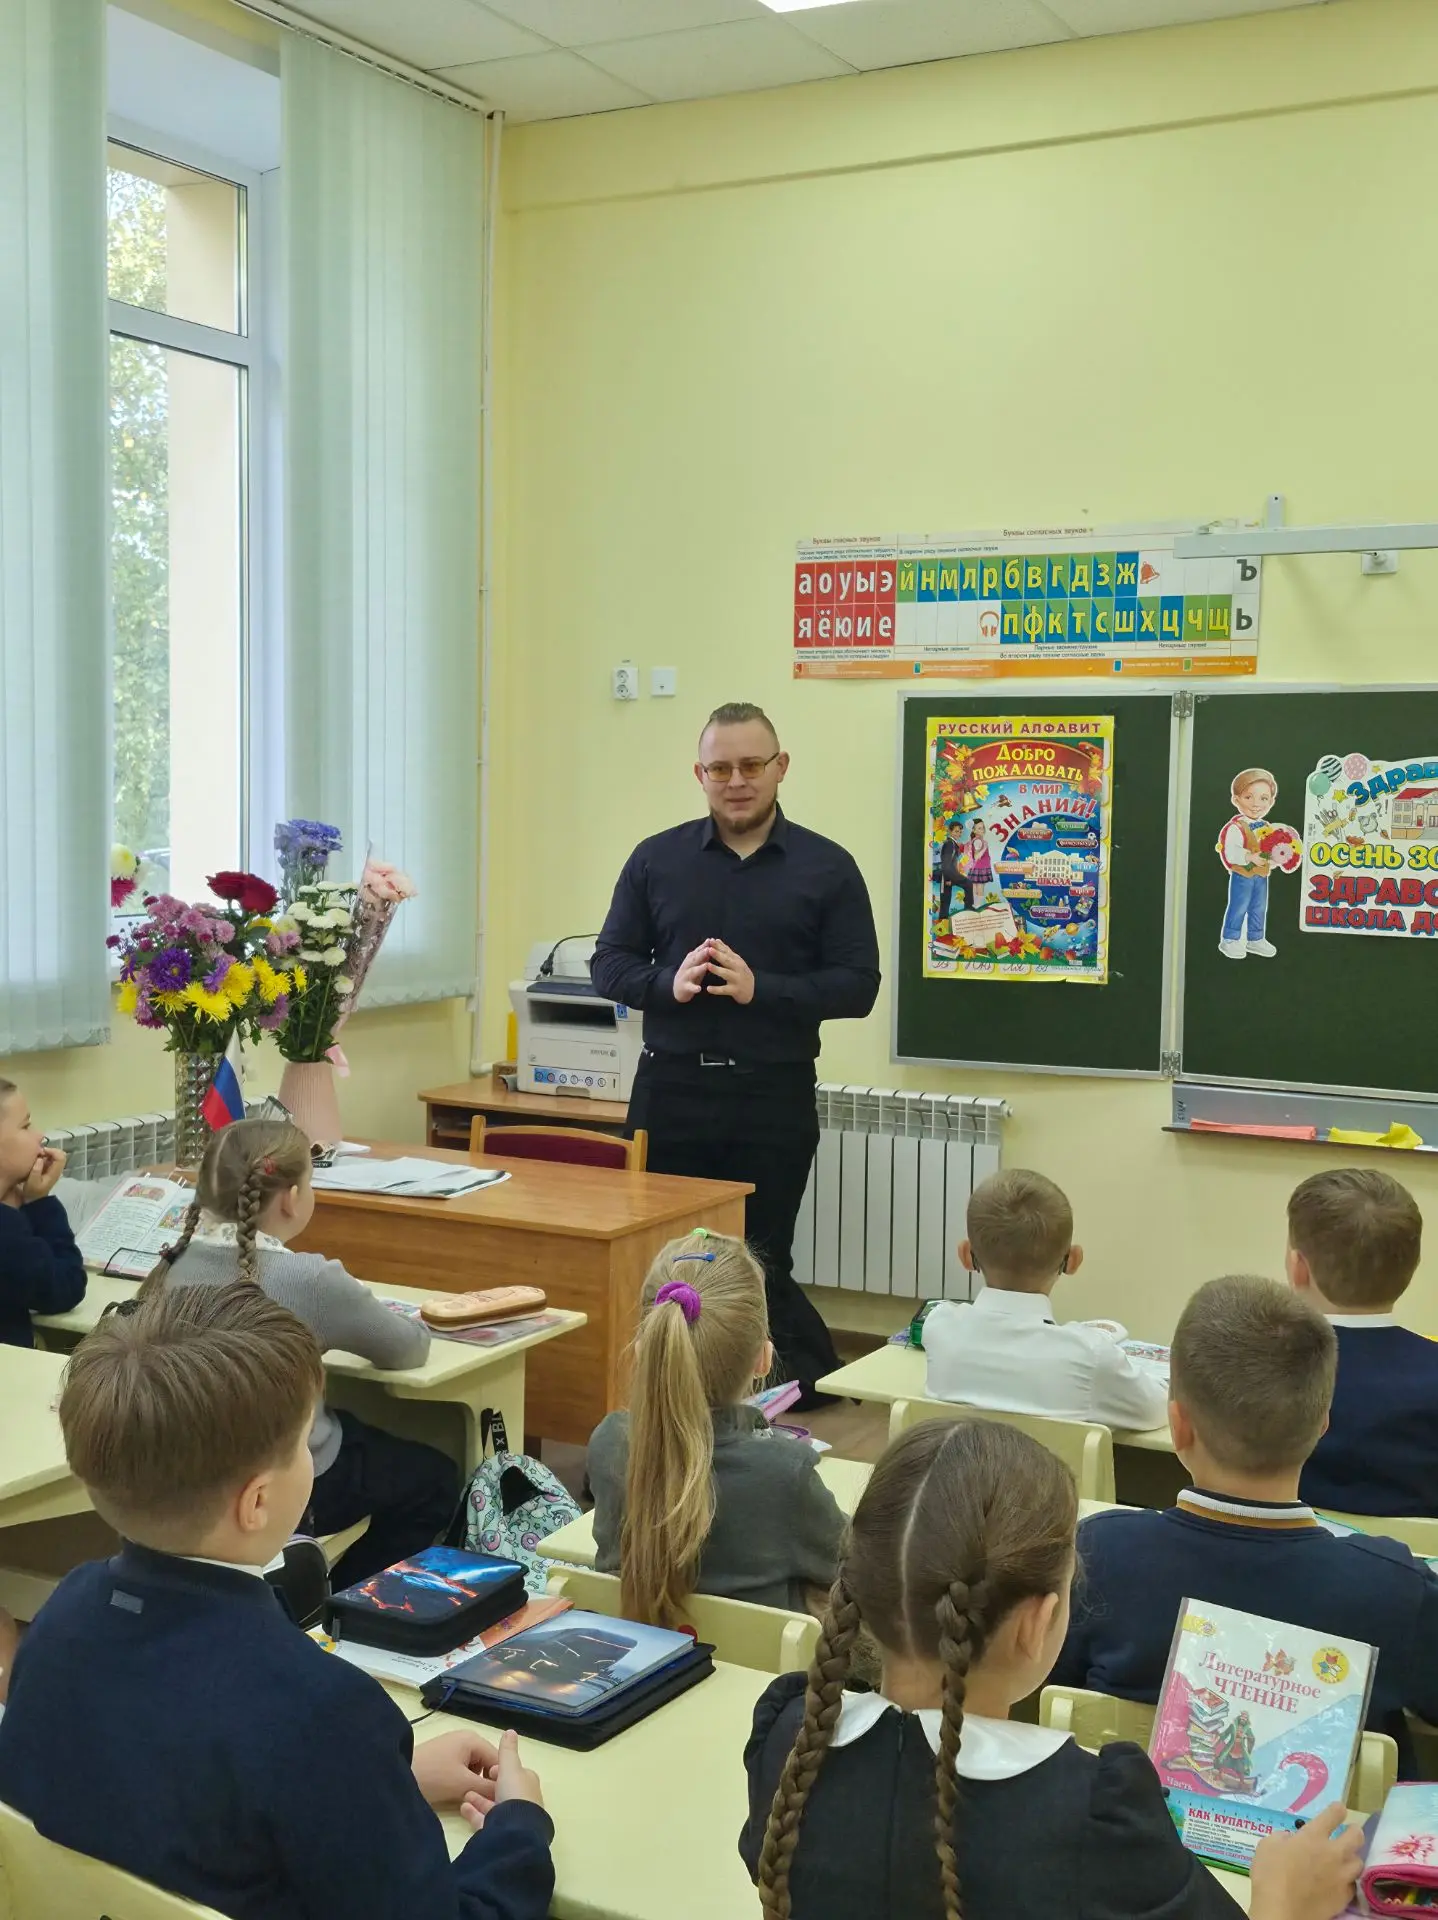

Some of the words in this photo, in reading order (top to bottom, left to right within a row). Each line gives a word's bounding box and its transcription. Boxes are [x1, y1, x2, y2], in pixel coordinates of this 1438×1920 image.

[799, 573, 812, 594] а
[819, 572, 832, 593] о
[839, 571, 851, 600] у
[856, 571, 875, 593] ы
[880, 570, 893, 592] э
[900, 562, 914, 591] й
[921, 569, 935, 590] н
[940, 568, 958, 590] м
[962, 568, 976, 589] л
[983, 567, 998, 596] р
[1005, 558, 1020, 589] б
[1027, 565, 1042, 588] в
[1051, 564, 1063, 587] г
[1071, 564, 1089, 592] д
[1096, 563, 1110, 586] з
[1116, 562, 1136, 585] ж
[798, 616, 812, 638] я
[818, 609, 831, 638] ё
[835, 616, 852, 637] ю
[856, 616, 871, 637] и
[879, 616, 892, 637] е
[1003, 614, 1018, 635] п
[1023, 605, 1043, 642] ф
[1048, 612, 1063, 634] к
[1072, 612, 1086, 634] т
[1095, 611, 1108, 633] с
[1115, 611, 1134, 633] ш
[1141, 609, 1155, 632] х
[1163, 609, 1179, 637] ц
[1187, 609, 1202, 631] ч
[1208, 608, 1229, 636] щ
[938, 722, 1013, 735] РУССКИЙ
[1020, 722, 1101, 734] АЛФАВИТ
[972, 763, 1083, 781] ПОЖАЛОВАТЬ
[1031, 784, 1063, 795] МИР
[989, 796, 1098, 843] ЗНАНИЙ!
[1309, 843, 1404, 870] ОСЕНЬ
[1036, 877, 1073, 887] ШКОЛА
[1306, 906, 1407, 931] ШКОЛА
[1198, 1650, 1321, 1699] Литературное
[1214, 1676, 1300, 1714] ЧТЕНИЕ
[1188, 1807, 1211, 1820] КАК
[1214, 1813, 1273, 1834] КУПАТЬСЯ
